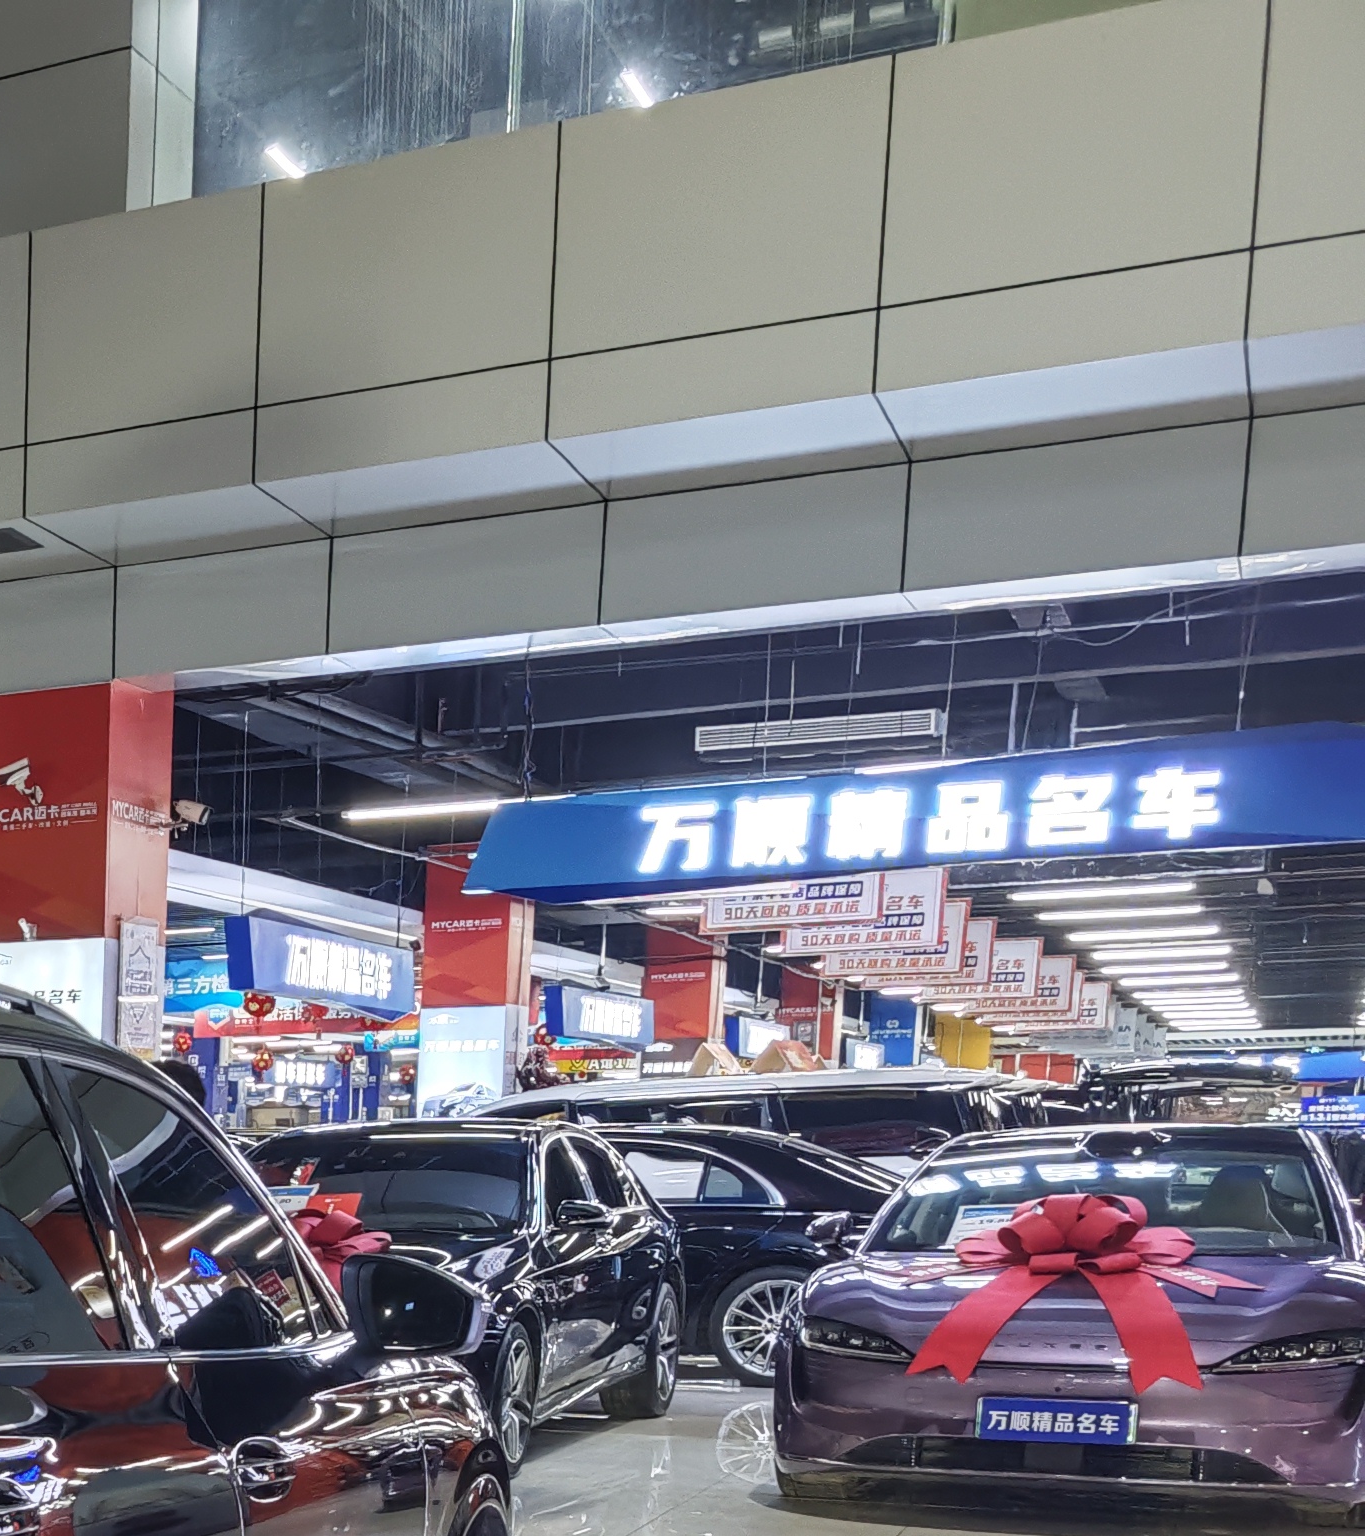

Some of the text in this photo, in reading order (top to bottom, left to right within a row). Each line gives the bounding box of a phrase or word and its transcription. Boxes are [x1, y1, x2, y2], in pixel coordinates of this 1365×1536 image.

[637, 766, 1221, 874] 万顺精品名车
[724, 900, 861, 920] 90天回购 质量承诺
[986, 1410, 1121, 1436] 万顺精品名车
